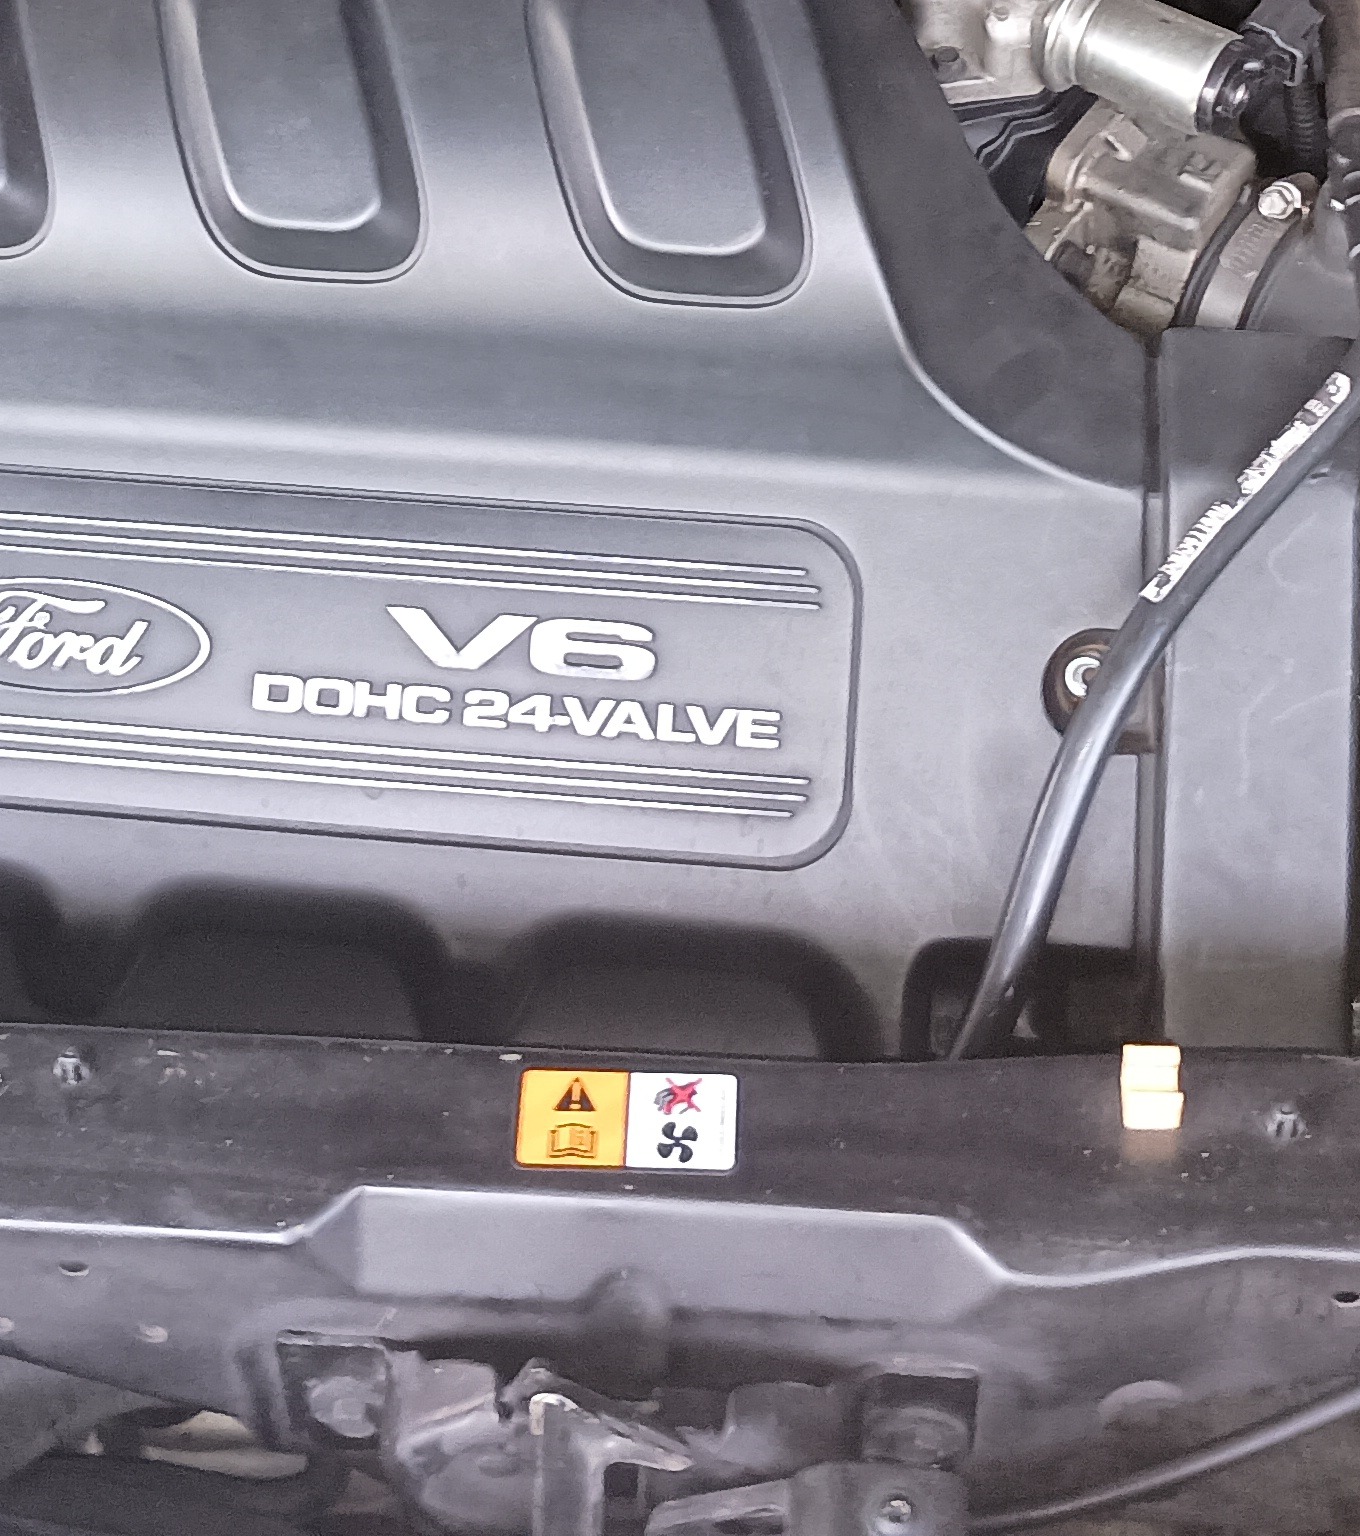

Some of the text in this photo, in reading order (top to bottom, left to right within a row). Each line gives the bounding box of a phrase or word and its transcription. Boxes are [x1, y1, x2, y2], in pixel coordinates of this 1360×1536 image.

[386, 604, 658, 682] V6
[250, 671, 782, 750] DOHC 24-VALVE
